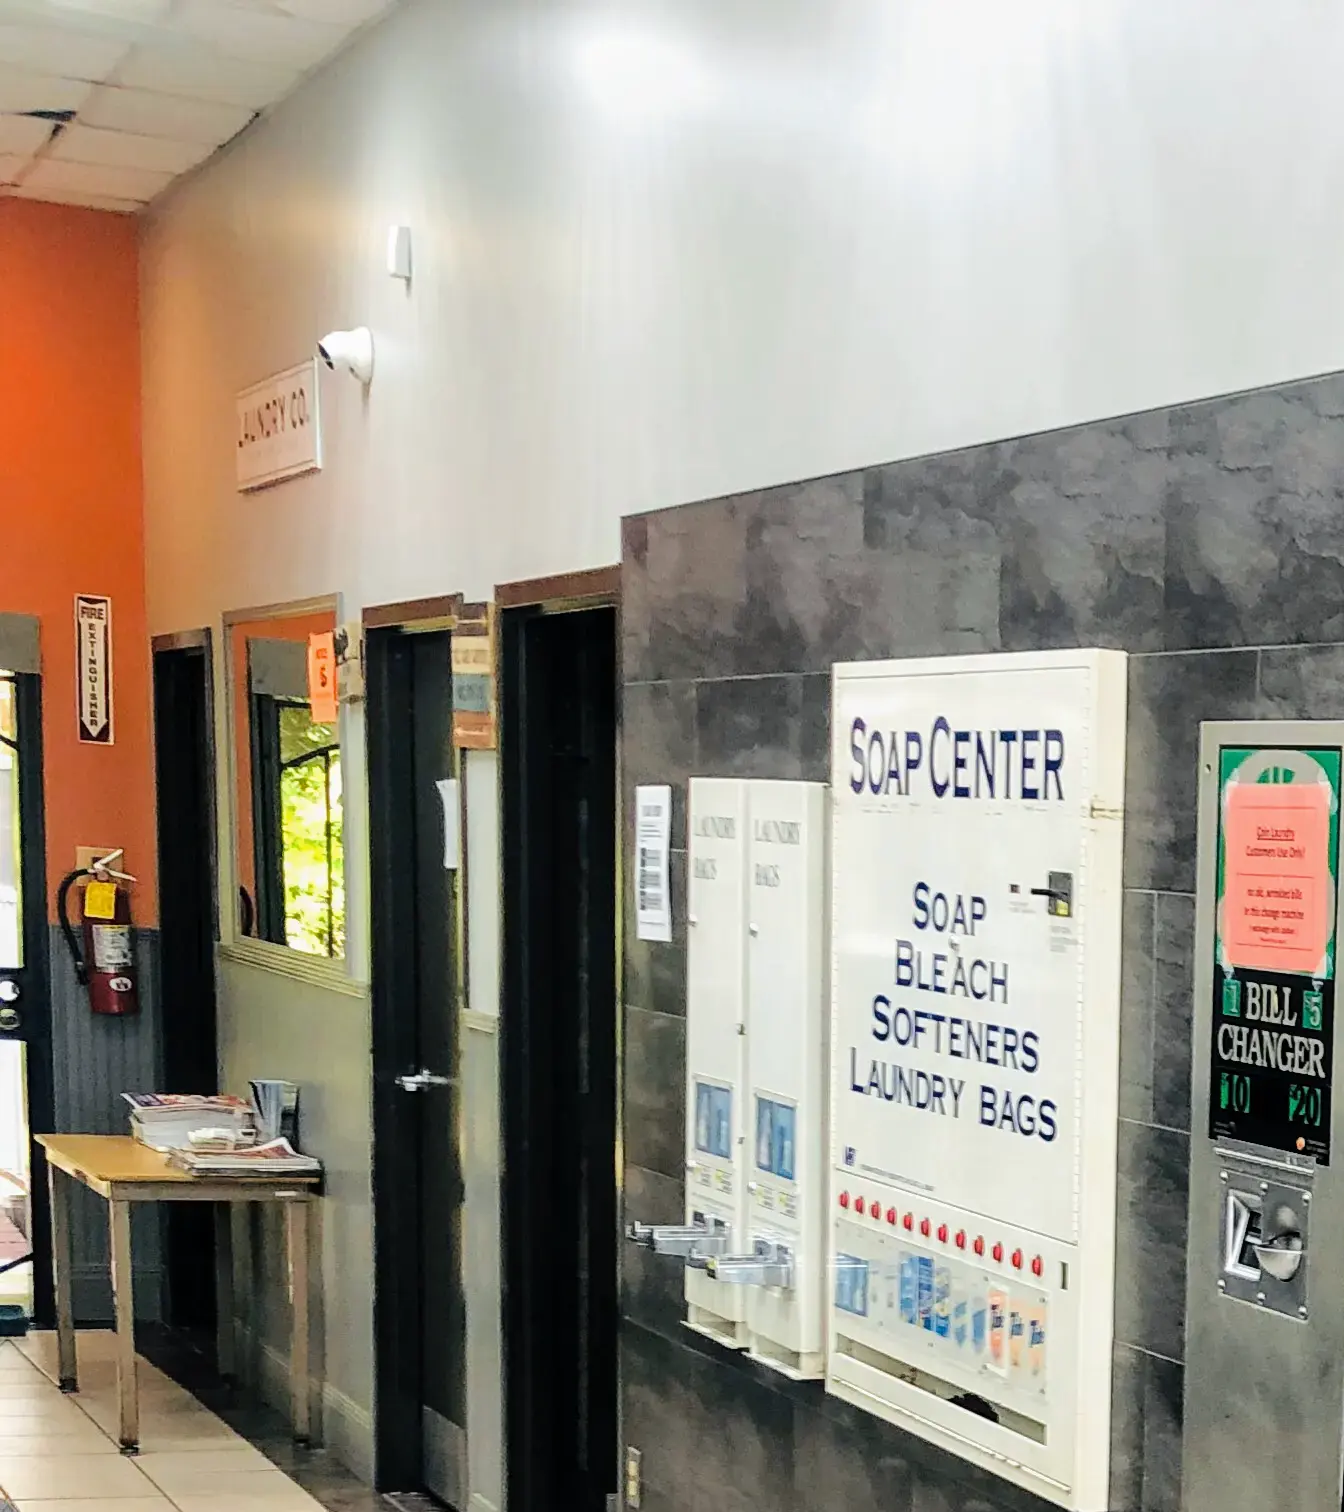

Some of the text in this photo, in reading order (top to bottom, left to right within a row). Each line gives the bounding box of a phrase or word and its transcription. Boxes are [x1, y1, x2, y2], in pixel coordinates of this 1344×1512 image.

[80, 606, 105, 620] FIRE
[88, 622, 99, 728] EXTINGUISHER
[912, 881, 987, 936] SOAP
[895, 938, 1010, 1004] BLEACH
[871, 994, 1041, 1074] SOFTENERS
[1246, 981, 1297, 1027] BILL
[1217, 1023, 1326, 1079] CHANGER
[849, 1046, 1058, 1143] LAUNDRY BAGS
